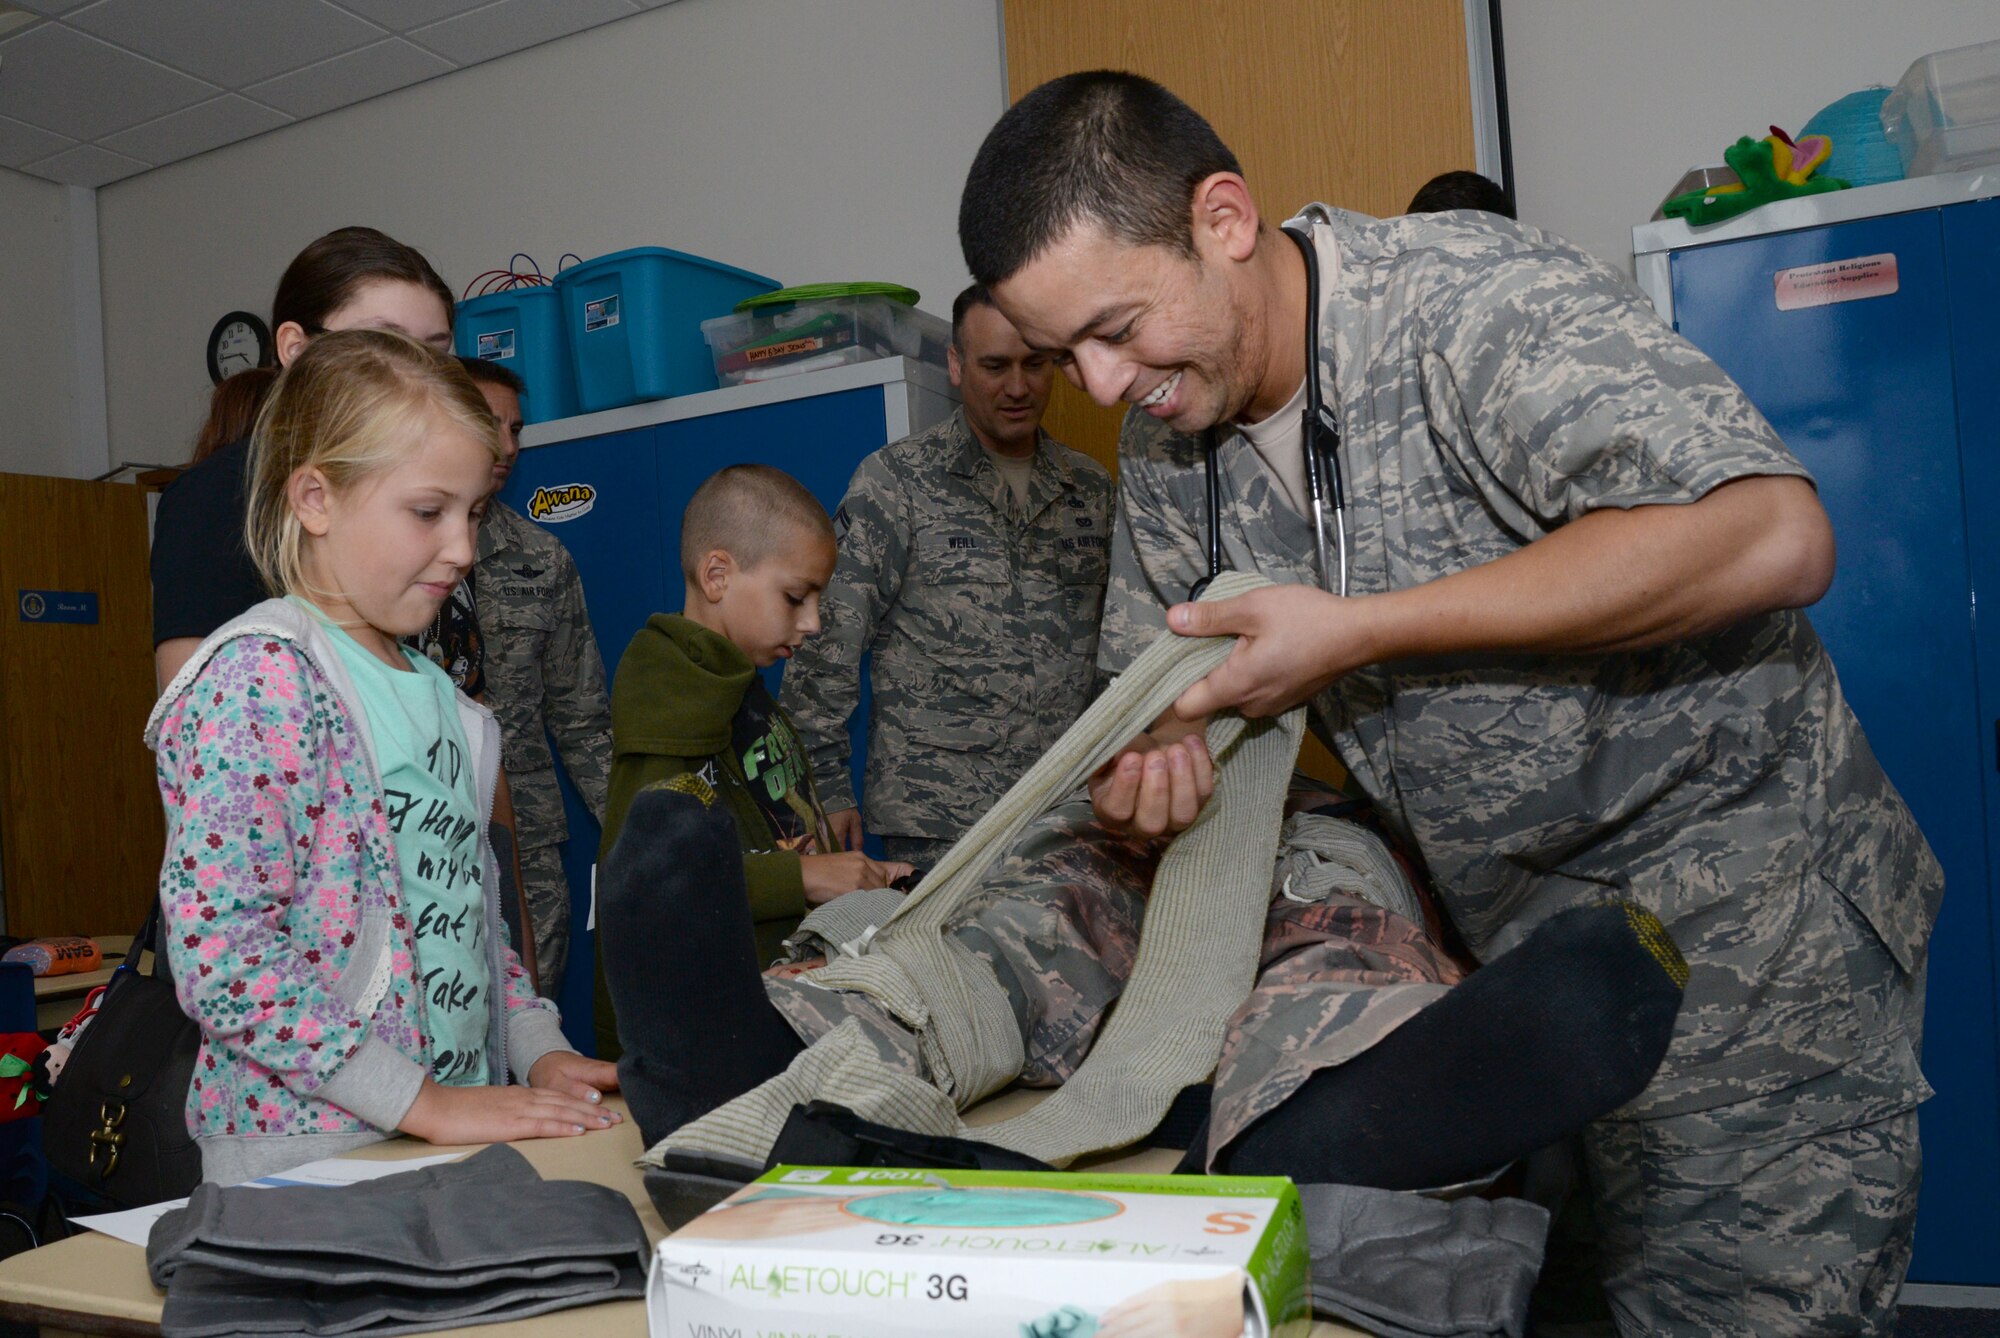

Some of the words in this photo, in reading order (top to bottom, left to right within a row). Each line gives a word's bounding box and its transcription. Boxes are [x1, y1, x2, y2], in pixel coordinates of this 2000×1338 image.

[1838, 260, 1882, 271] Religious
[1840, 272, 1880, 283] Supplies
[532, 486, 591, 518] Awana
[948, 537, 977, 549] WEILL
[1077, 535, 1091, 548] AIR
[521, 586, 536, 597] AIR
[415, 902, 469, 943] Eat
[55, 945, 94, 961] SAM
[422, 966, 478, 1013] Take
[1203, 1212, 1257, 1235] S
[875, 1233, 924, 1246] 3G
[926, 1274, 968, 1300] 3G
